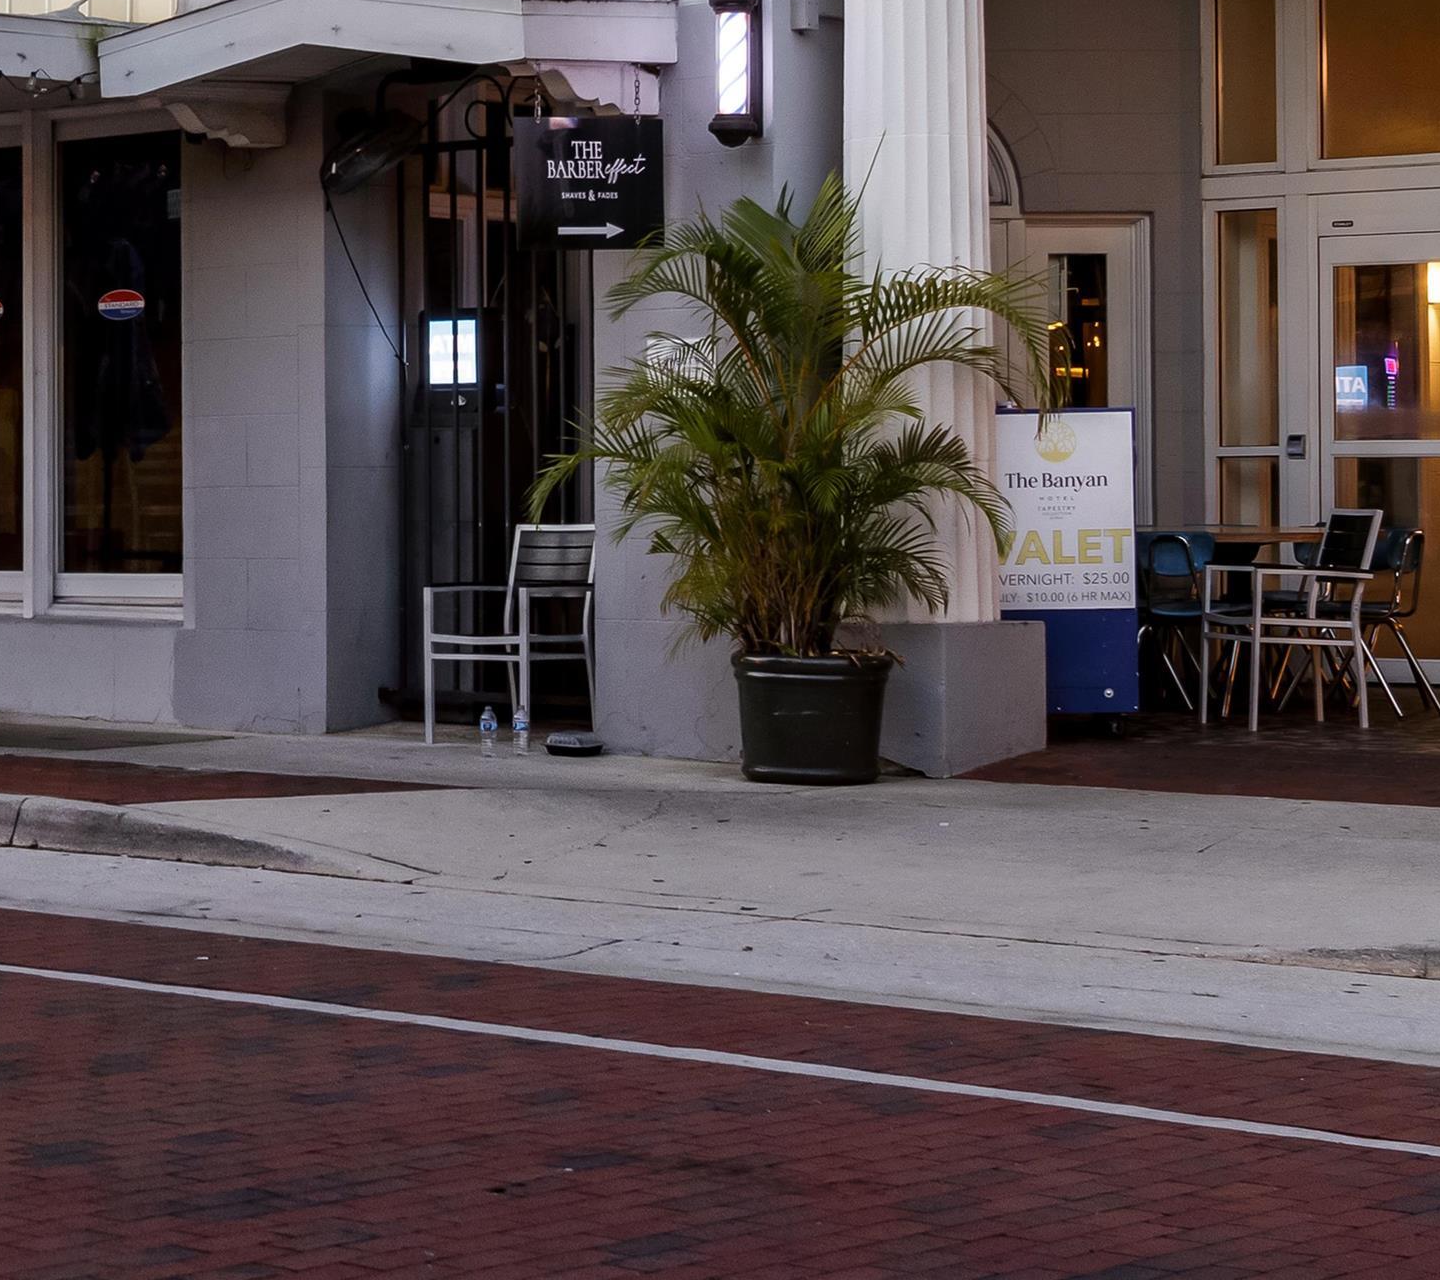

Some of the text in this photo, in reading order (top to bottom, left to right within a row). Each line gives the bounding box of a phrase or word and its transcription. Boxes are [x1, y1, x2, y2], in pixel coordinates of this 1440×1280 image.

[571, 140, 603, 160] THE
[547, 153, 646, 184] BARBER effect
[561, 189, 618, 201] SHAVES & FADES
[1004, 472, 1108, 493] The Banyan
[998, 571, 1130, 586] VERNIGHT: $25.00
[1026, 591, 1064, 603] $10.00
[1067, 592, 1078, 604] (6
[1081, 592, 1098, 601] HR
[1100, 591, 1132, 603] MAX)
